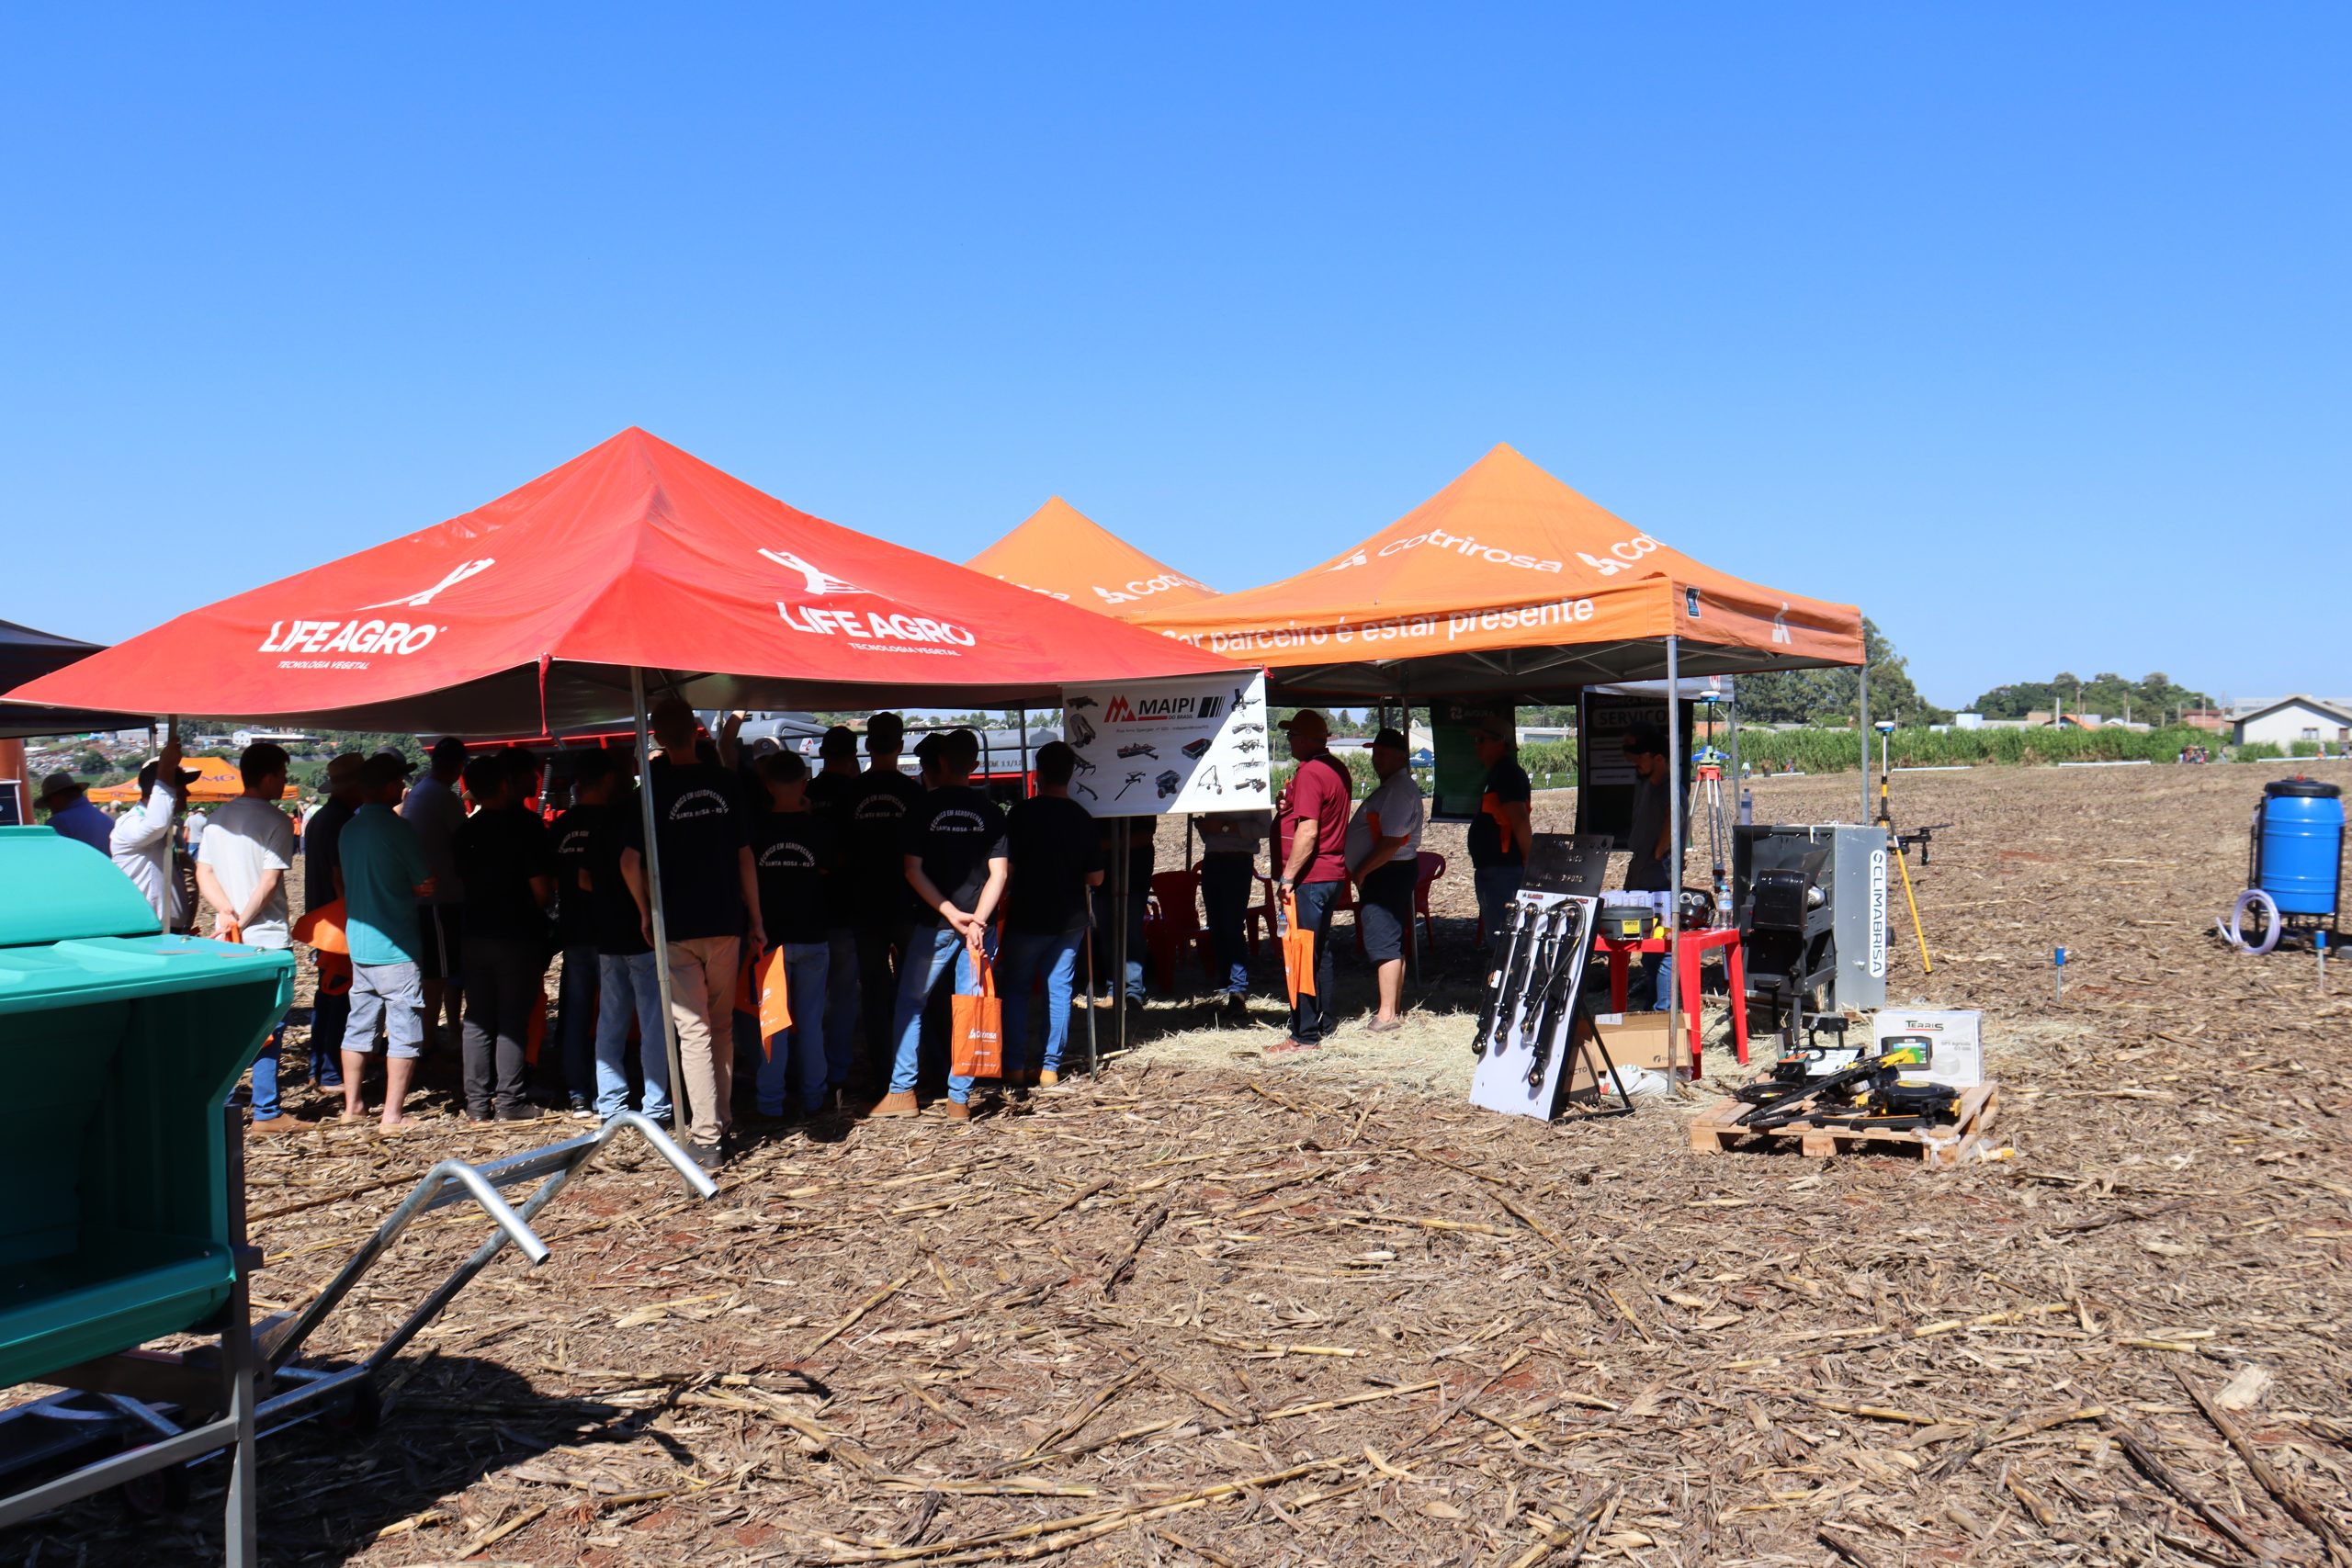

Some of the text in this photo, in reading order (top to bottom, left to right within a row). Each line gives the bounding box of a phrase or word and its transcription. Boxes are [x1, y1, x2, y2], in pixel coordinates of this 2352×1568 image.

[257, 619, 437, 655] LIFE AGRO
[776, 602, 976, 647] LIFE AGRO
[1210, 620, 1329, 653] parceiro
[1335, 616, 1353, 643] é
[1361, 616, 1441, 641] estar
[1447, 597, 1595, 640] presente
[277, 660, 371, 670] TECNOLOGIA VEGETAL
[847, 642, 962, 657] TECNOLOGIA VEGETAL
[1138, 697, 1196, 715] MAIPI
[1872, 865, 1883, 974] CLIMABRISA
